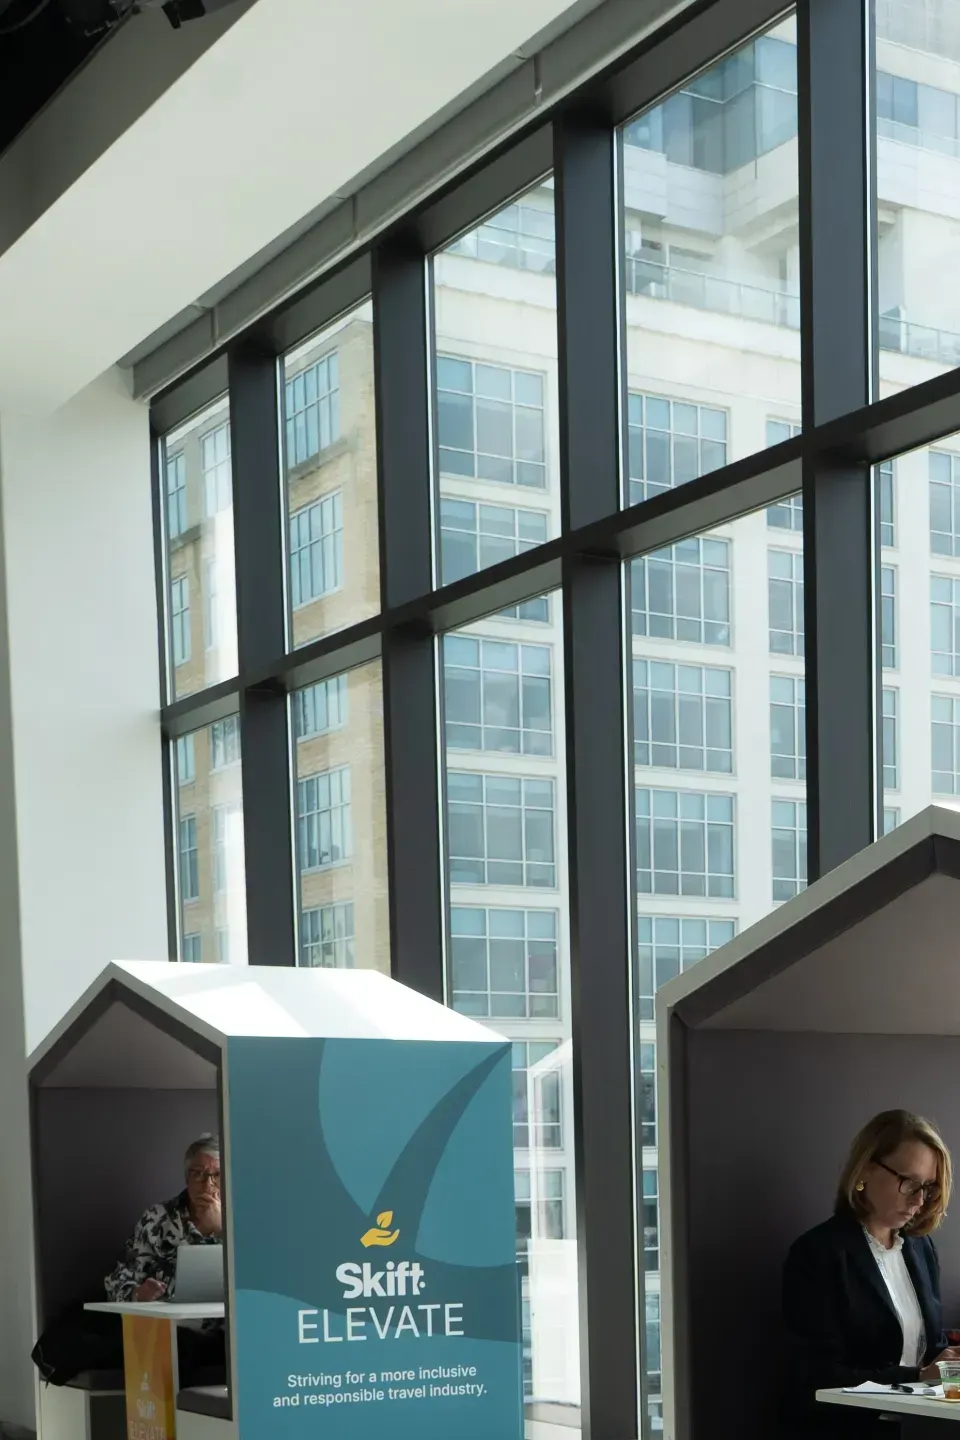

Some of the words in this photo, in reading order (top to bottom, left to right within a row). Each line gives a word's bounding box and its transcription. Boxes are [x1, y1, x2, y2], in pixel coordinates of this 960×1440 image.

[298, 1303, 465, 1344] ELEVATE
[287, 1372, 342, 1388] Striving
[346, 1371, 365, 1384] for
[369, 1372, 377, 1383] a
[381, 1369, 415, 1383] more
[418, 1365, 477, 1380] inclusive
[273, 1393, 300, 1408] and
[303, 1388, 385, 1407] responsible
[388, 1384, 426, 1400] travel
[429, 1382, 488, 1400] industry.
